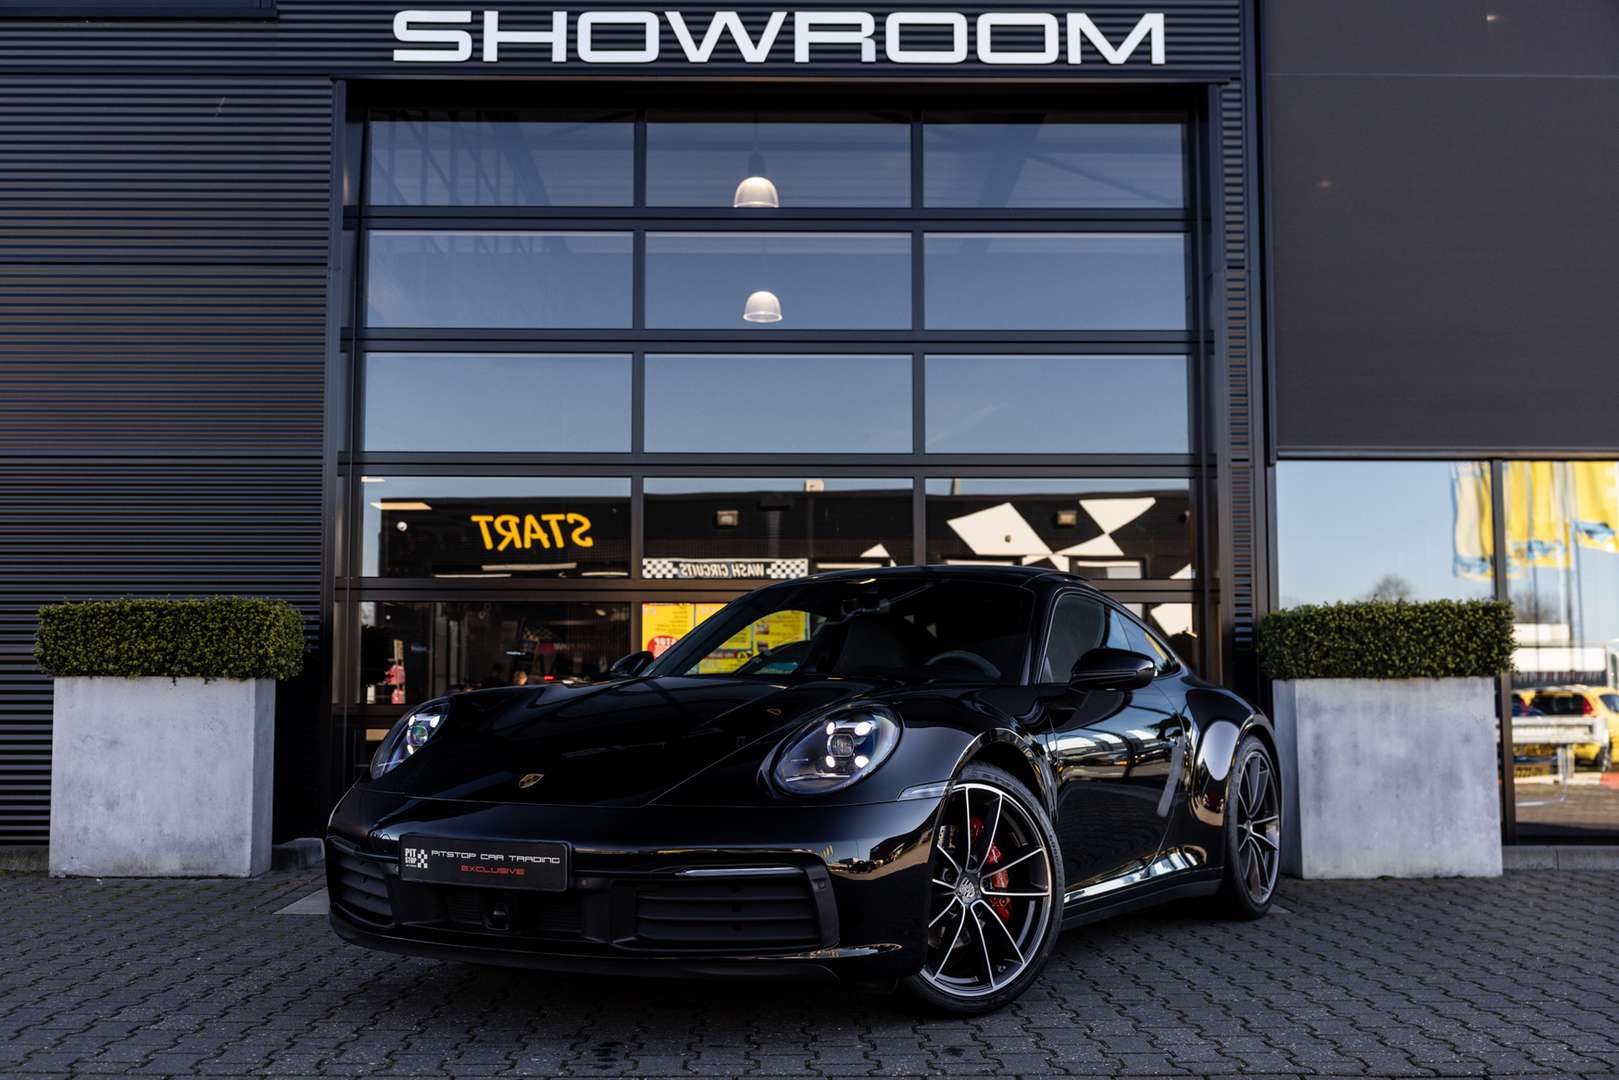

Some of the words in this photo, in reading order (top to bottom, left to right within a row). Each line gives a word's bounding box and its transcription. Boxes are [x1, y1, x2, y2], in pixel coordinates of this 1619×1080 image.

[393, 10, 1165, 65] SHOWROOM
[405, 848, 417, 857] PIT
[431, 850, 477, 859] PITSTOP
[480, 853, 505, 861] CAR
[508, 855, 561, 864] TRADING
[461, 864, 526, 875] EXCLUSIVE
